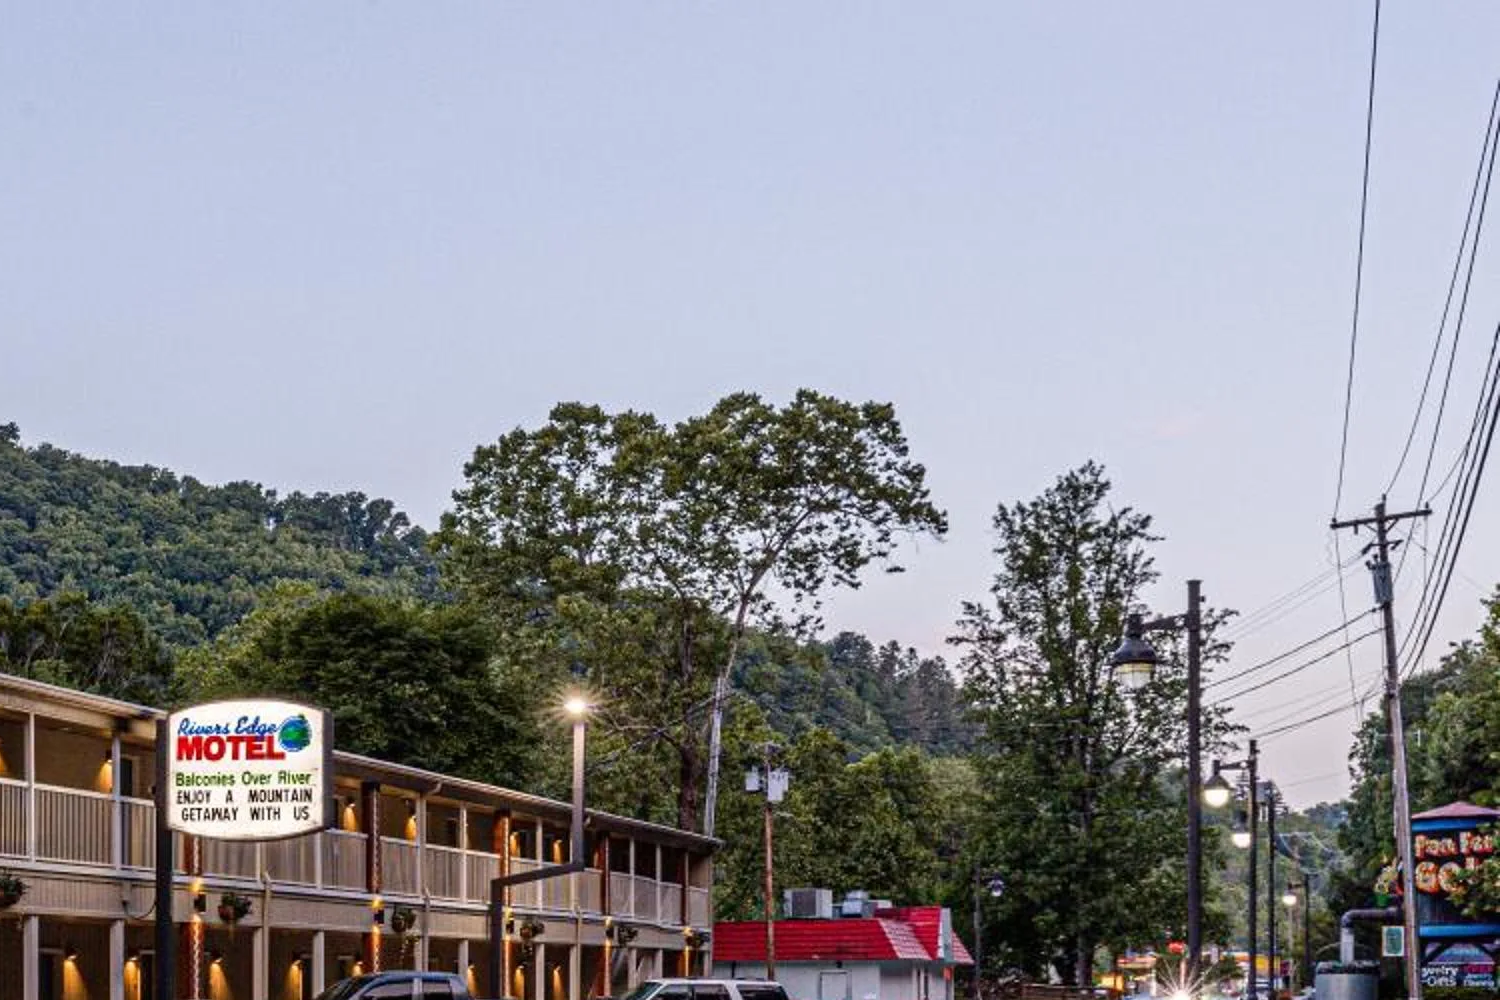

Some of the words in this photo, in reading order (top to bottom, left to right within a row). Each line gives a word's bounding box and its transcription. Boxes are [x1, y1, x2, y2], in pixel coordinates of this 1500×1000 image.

[178, 717, 230, 735] Rivers
[235, 715, 280, 741] Edge
[176, 735, 286, 761] MOTEL
[175, 771, 236, 787] Balconies
[241, 770, 272, 785] Over
[278, 769, 312, 785] River
[176, 789, 212, 805] ENJOY
[225, 789, 234, 803] A
[248, 788, 313, 803] MOUNTAIN
[181, 806, 238, 822] GETAWAY
[249, 806, 281, 821] WITH
[293, 805, 311, 821] US
[1414, 833, 1458, 858] Pan
